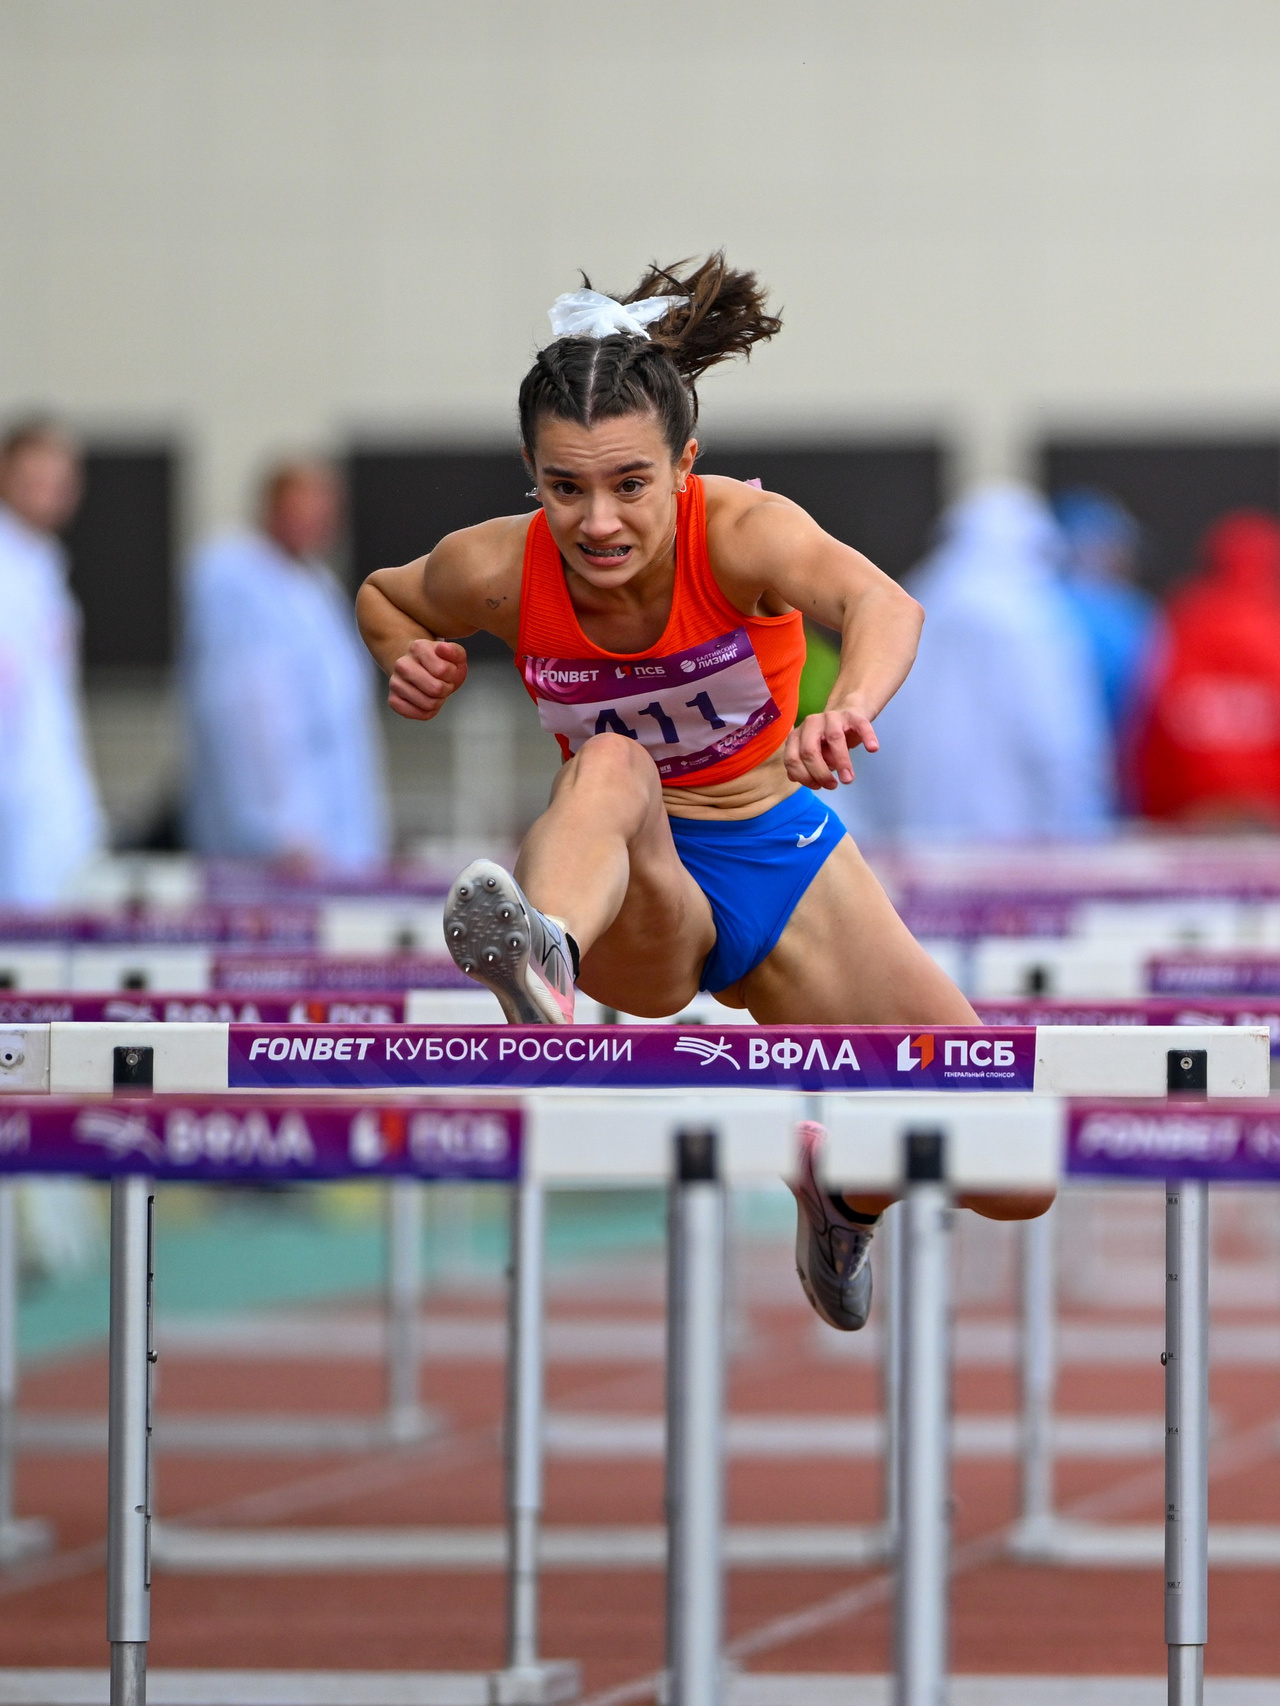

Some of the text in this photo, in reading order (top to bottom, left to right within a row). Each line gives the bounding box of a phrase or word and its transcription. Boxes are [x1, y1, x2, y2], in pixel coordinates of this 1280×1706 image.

[696, 642, 738, 662] БАЛТИЙСКИЙ
[698, 648, 739, 669] ЛИЗИНГ
[540, 669, 600, 683] FONBET
[634, 666, 666, 676] ПСБ
[594, 690, 727, 744] 411
[249, 1037, 375, 1061] FONBET
[385, 1037, 632, 1062] КУБОК РОССИИ
[748, 1037, 861, 1071] ВФЛА
[944, 1040, 1015, 1066] ПСБ
